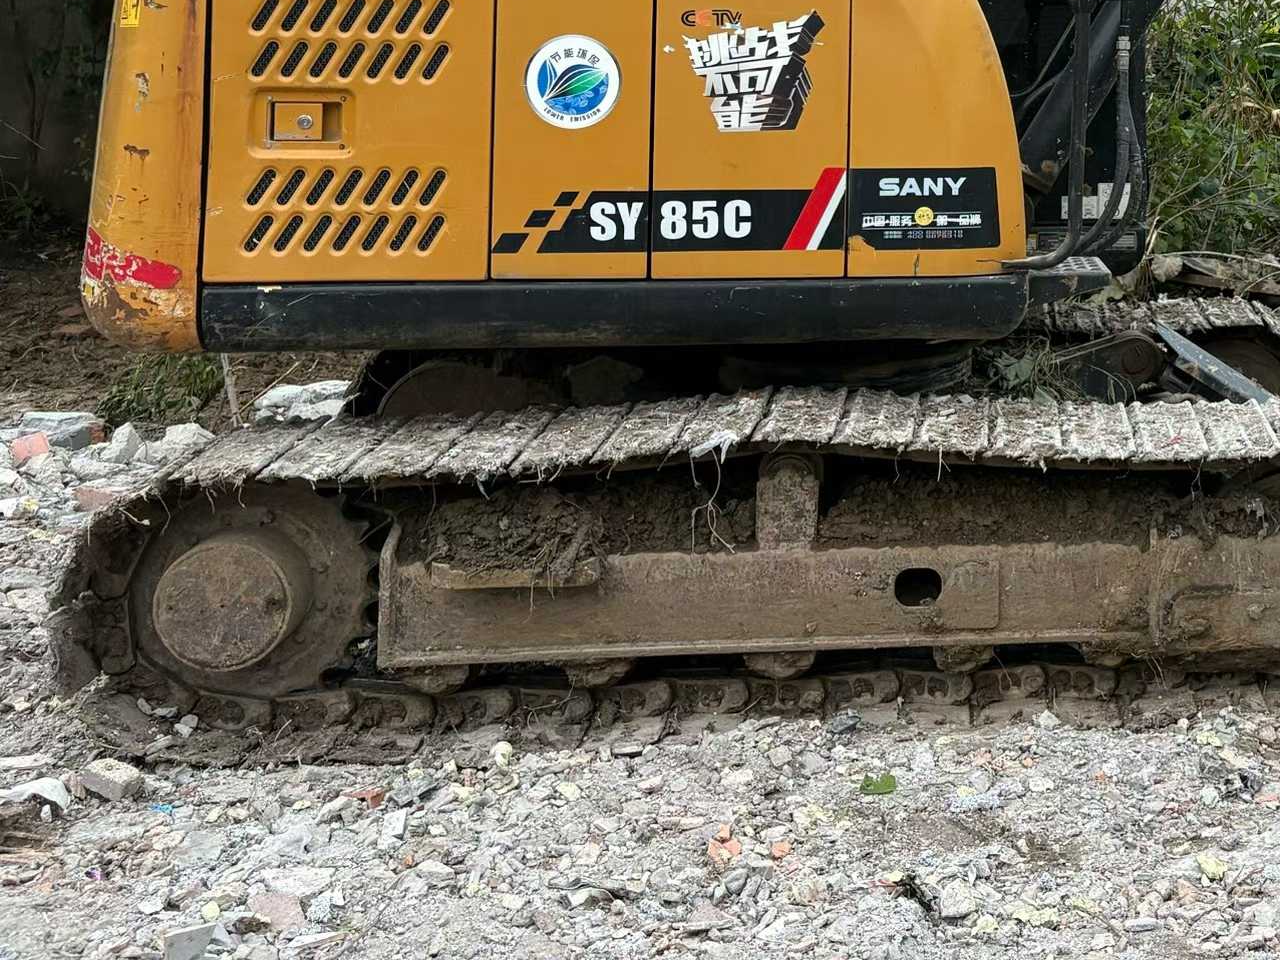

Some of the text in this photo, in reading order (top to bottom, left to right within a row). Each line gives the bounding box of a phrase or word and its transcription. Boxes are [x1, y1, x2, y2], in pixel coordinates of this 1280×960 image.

[681, 10, 742, 27] CCTV
[683, 10, 815, 68] 挑战
[550, 48, 600, 69] 节能环保
[693, 56, 792, 97] 不可
[711, 94, 774, 132] 能
[879, 177, 967, 197] SANY
[589, 199, 752, 241] SY 85C
